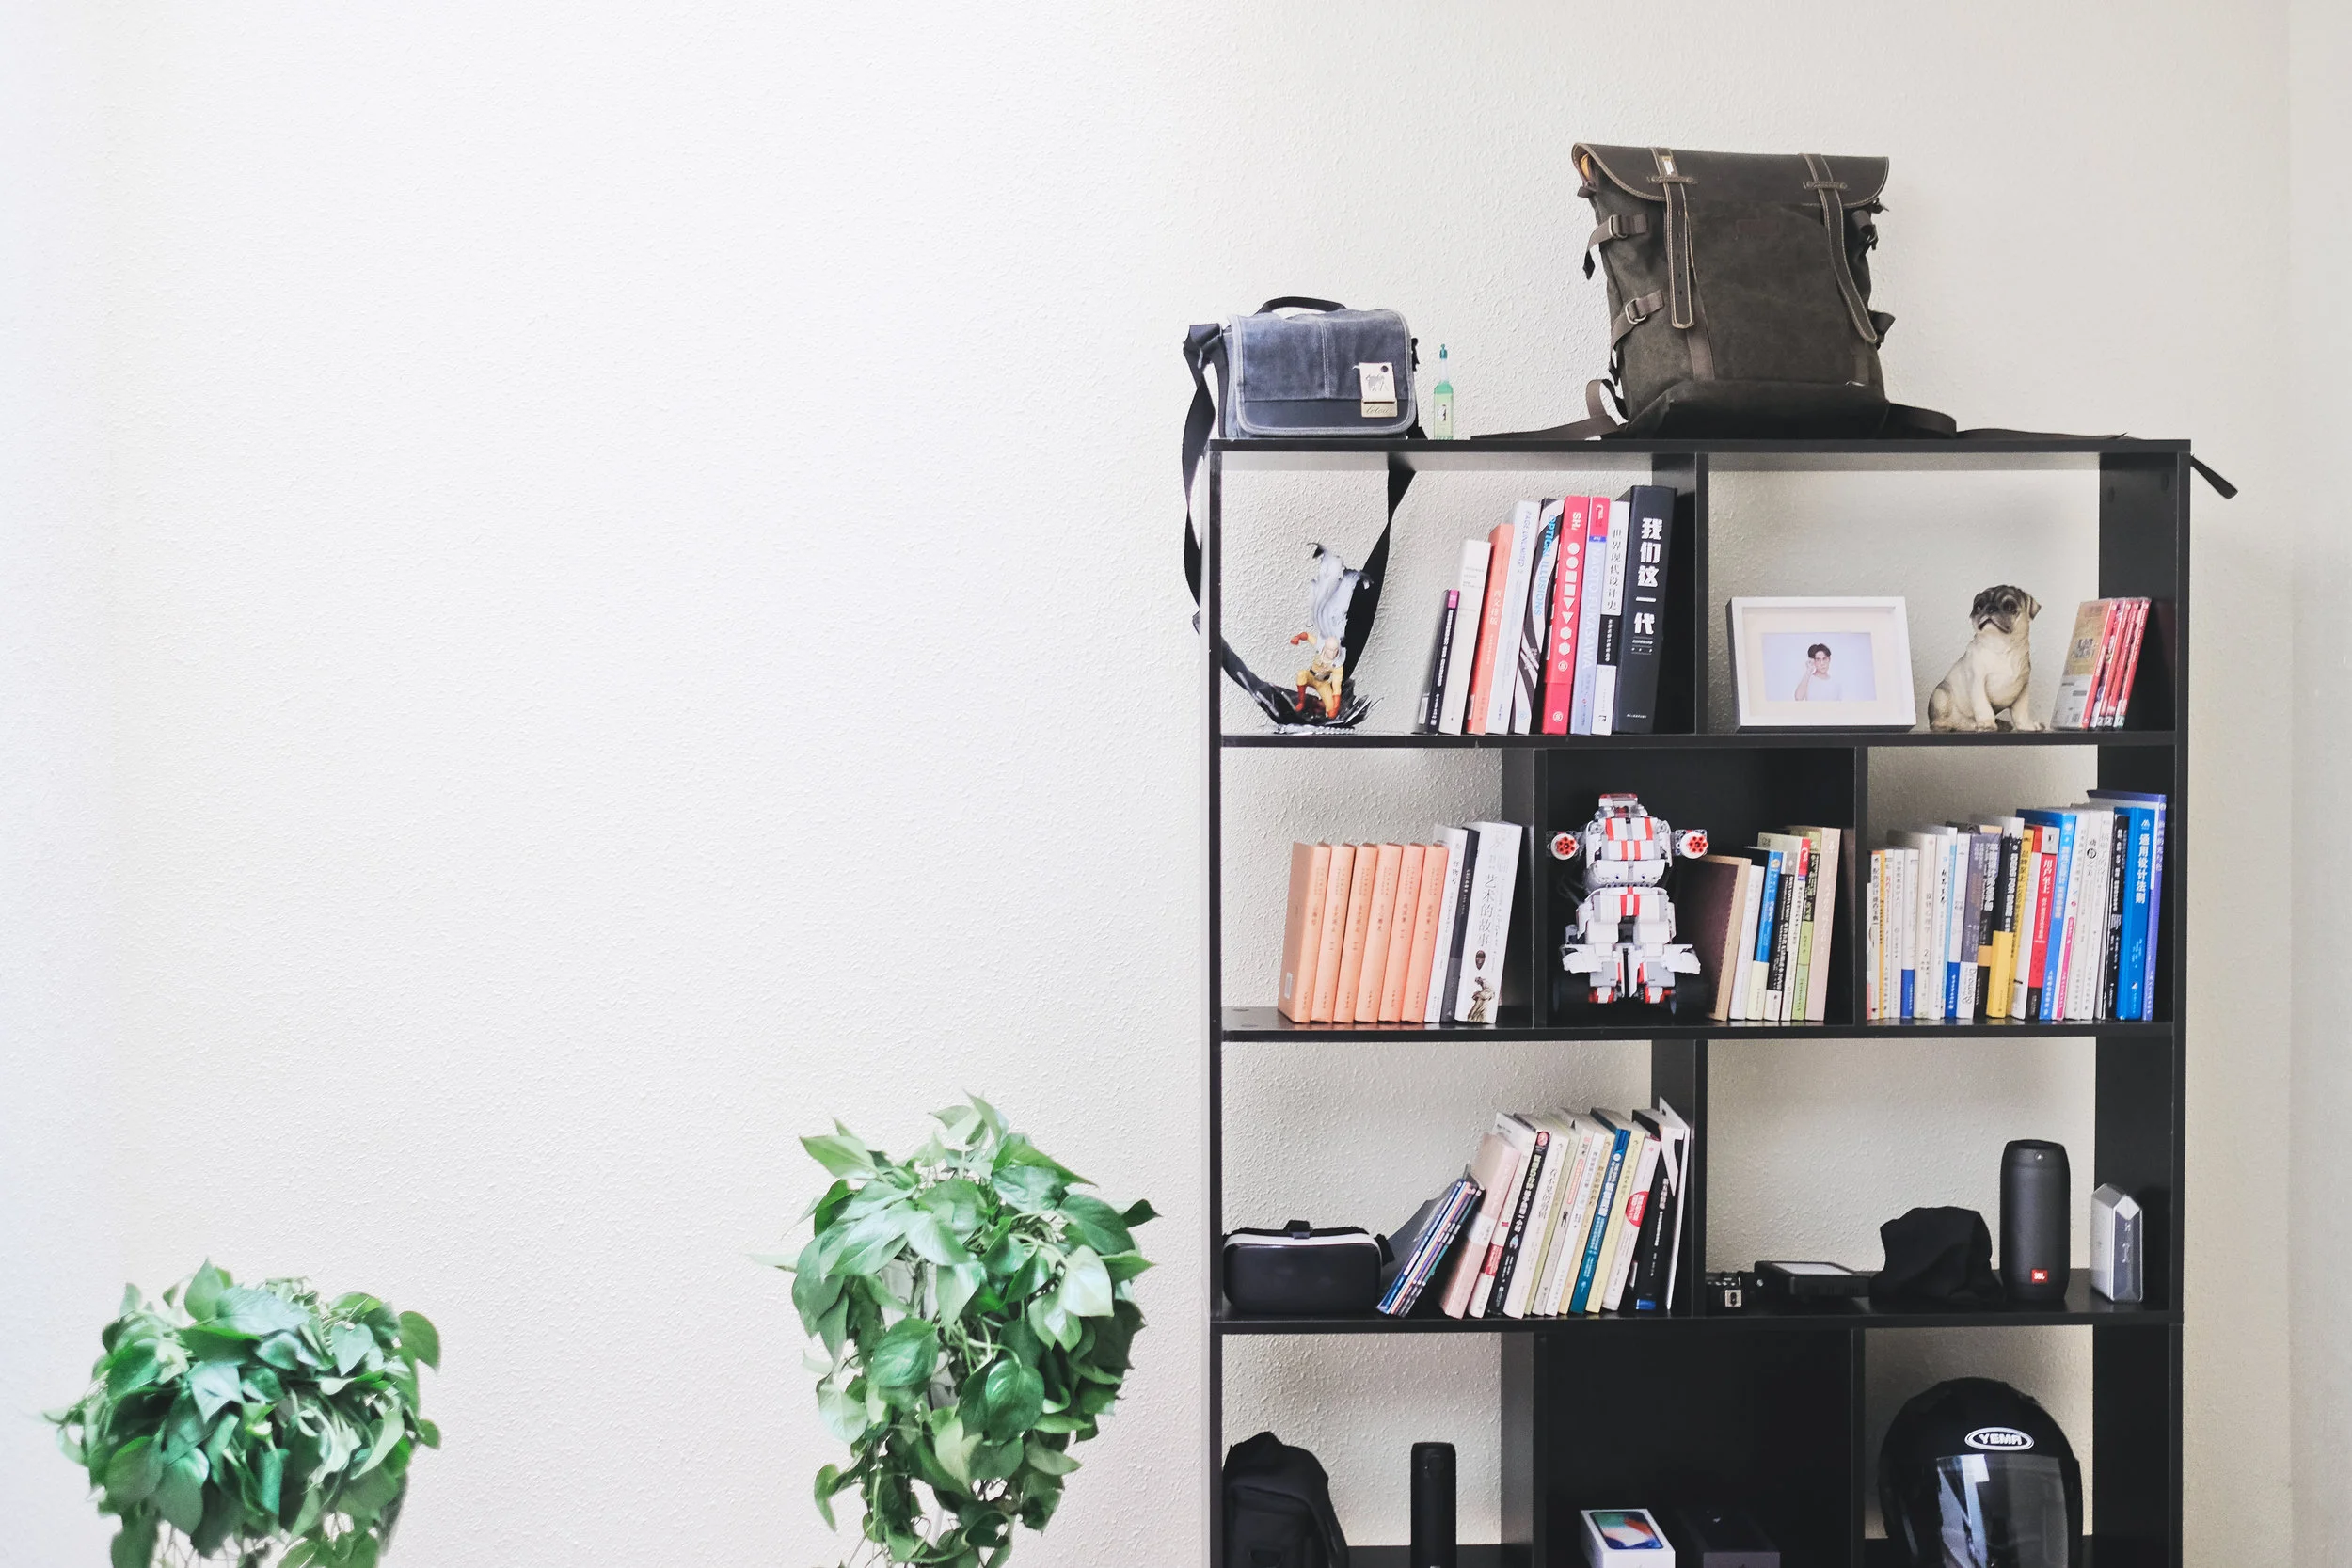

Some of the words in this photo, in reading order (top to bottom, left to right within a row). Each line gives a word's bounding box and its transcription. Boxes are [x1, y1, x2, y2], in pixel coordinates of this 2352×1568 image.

[1542, 515, 1557, 557] OPTICAL
[1534, 560, 1549, 617] ILLUSIONS
[1588, 547, 1601, 593] NAOTO
[1607, 528, 1622, 610] 世界现代设计史
[1634, 517, 1663, 635] 我们这一代
[1581, 595, 1597, 670] FUKASAWA
[2136, 833, 2150, 904] 通用设计法则
[1478, 874, 1497, 947] 艺术的故事
[2034, 1272, 2045, 1280] JBL
[1979, 1433, 2023, 1446] YEMA
